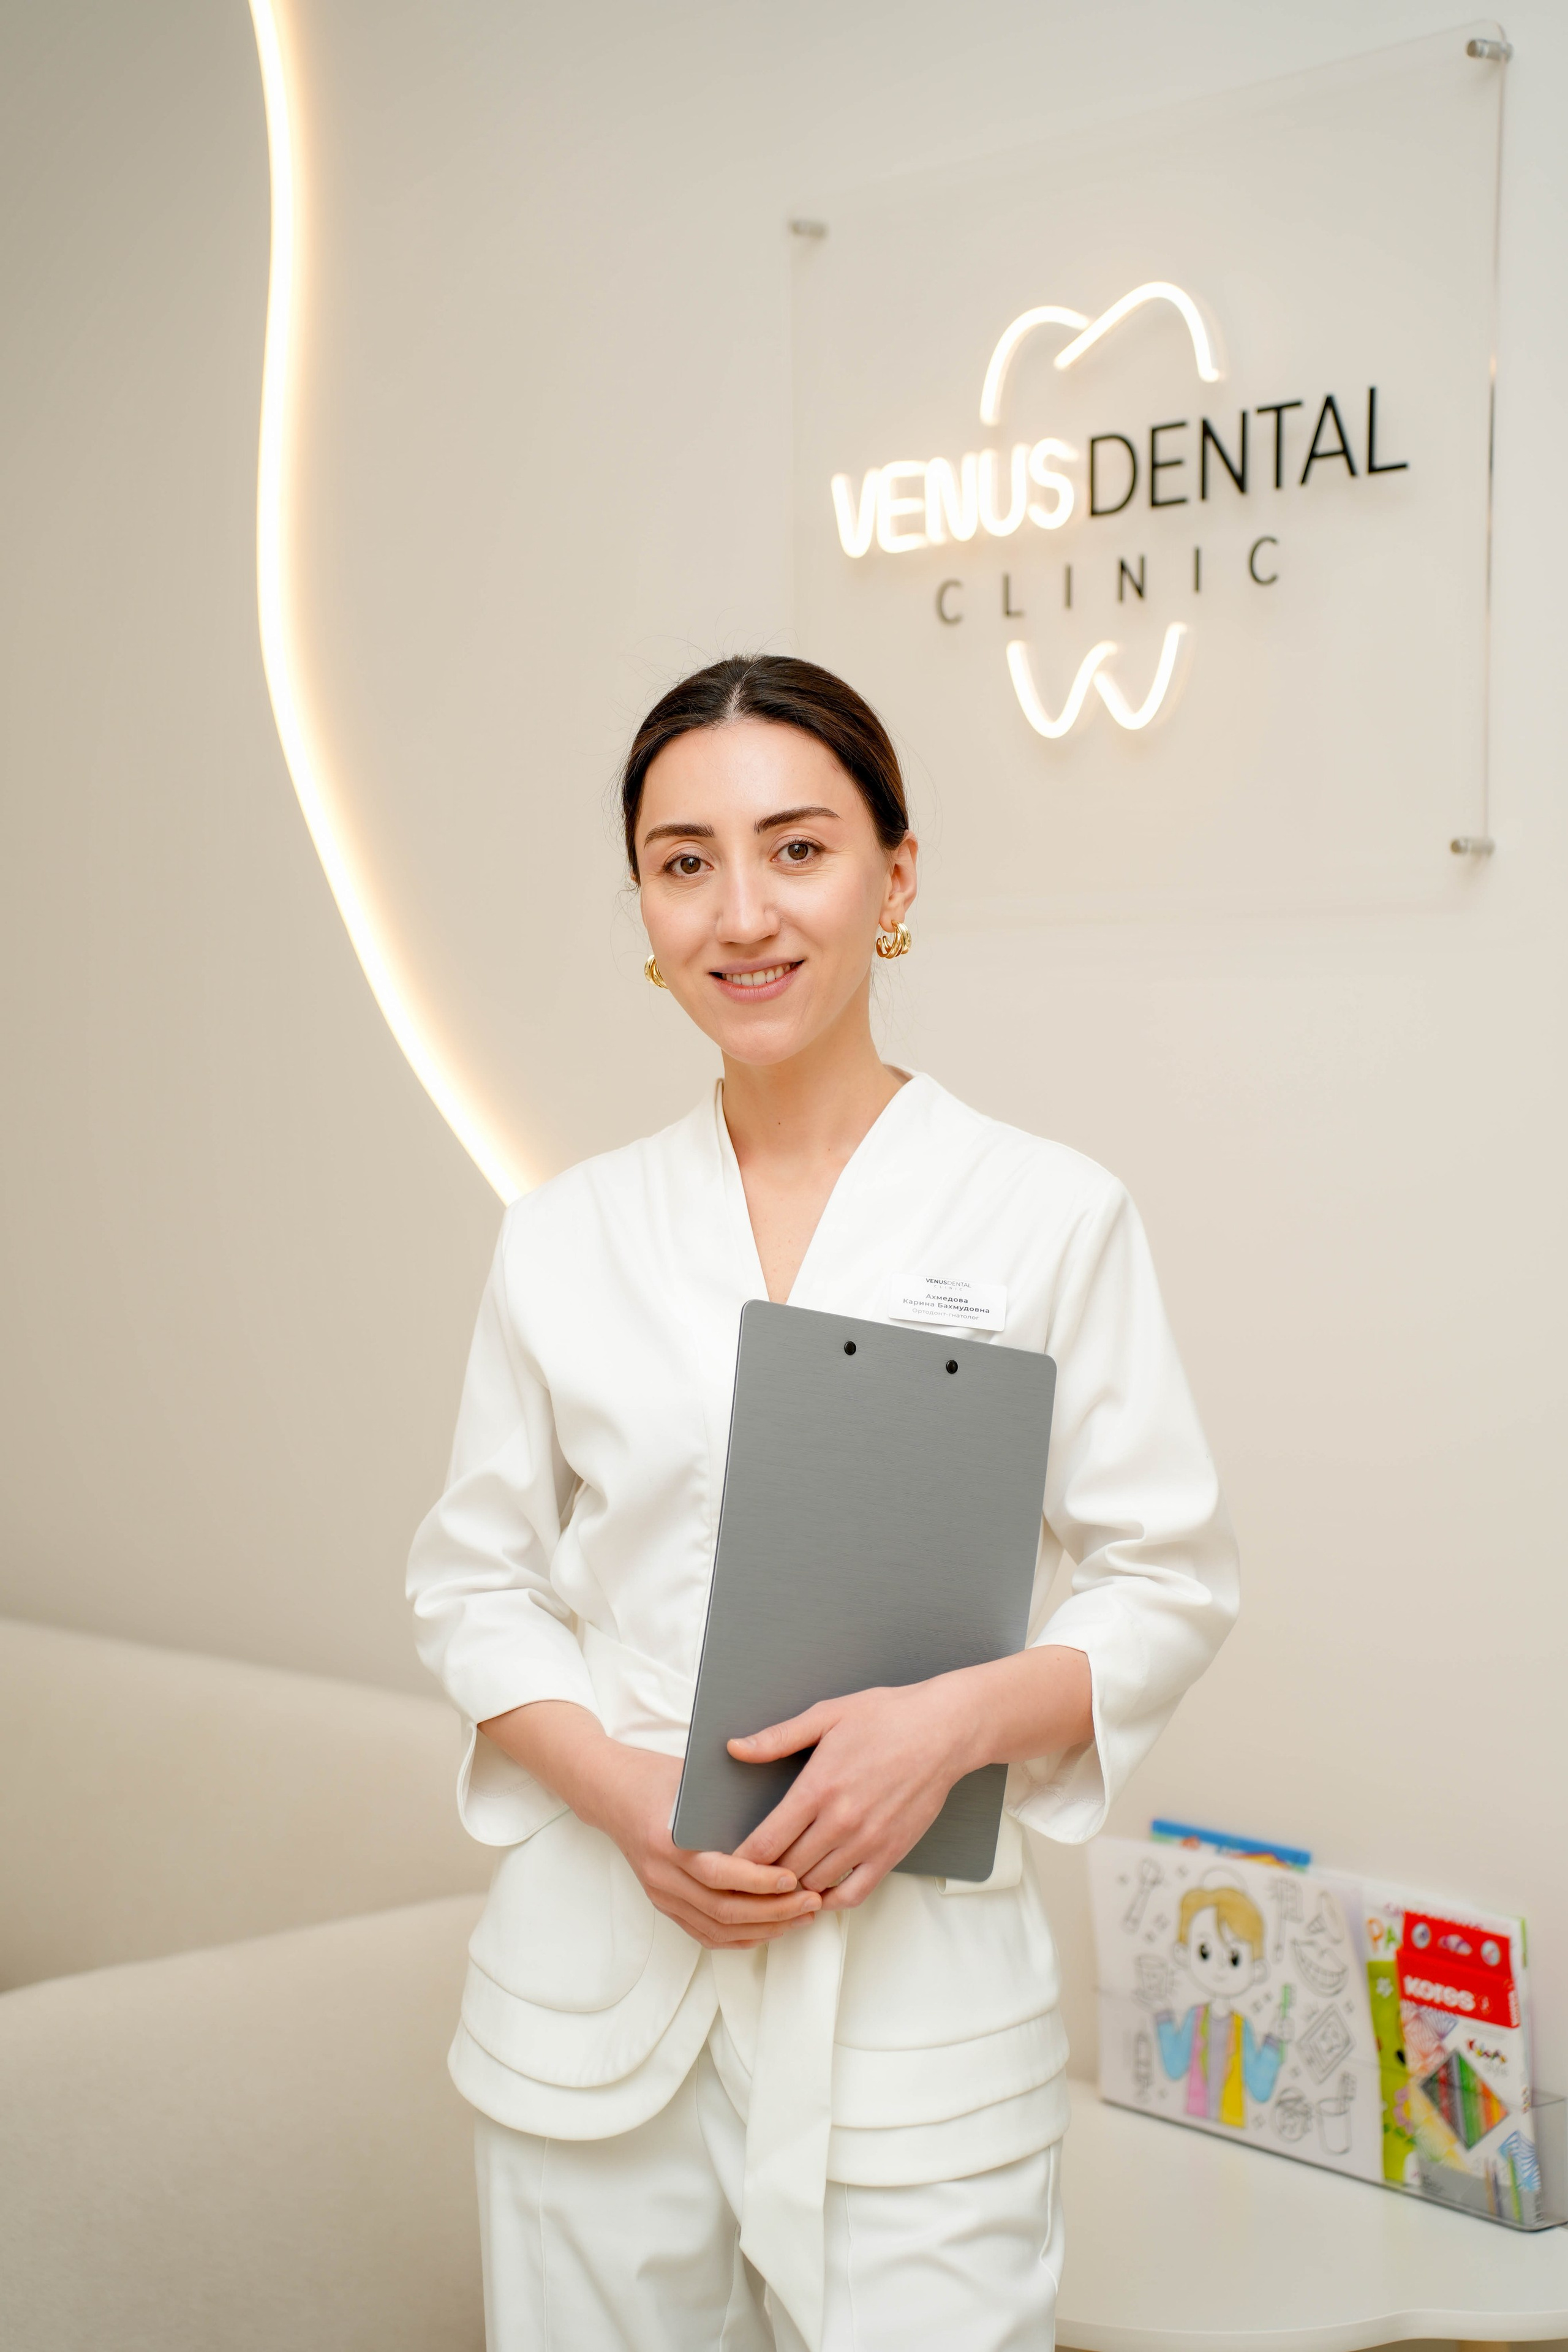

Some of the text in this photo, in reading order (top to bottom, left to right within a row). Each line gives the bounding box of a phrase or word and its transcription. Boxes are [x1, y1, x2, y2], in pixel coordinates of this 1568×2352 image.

[935, 537, 1279, 625] CLINIC
[925, 1294, 968, 1303] Ахмедова
[903, 1298, 990, 1314] Карина Бахмудовна
[912, 1308, 980, 1321] Ортодонт-гнатолог
